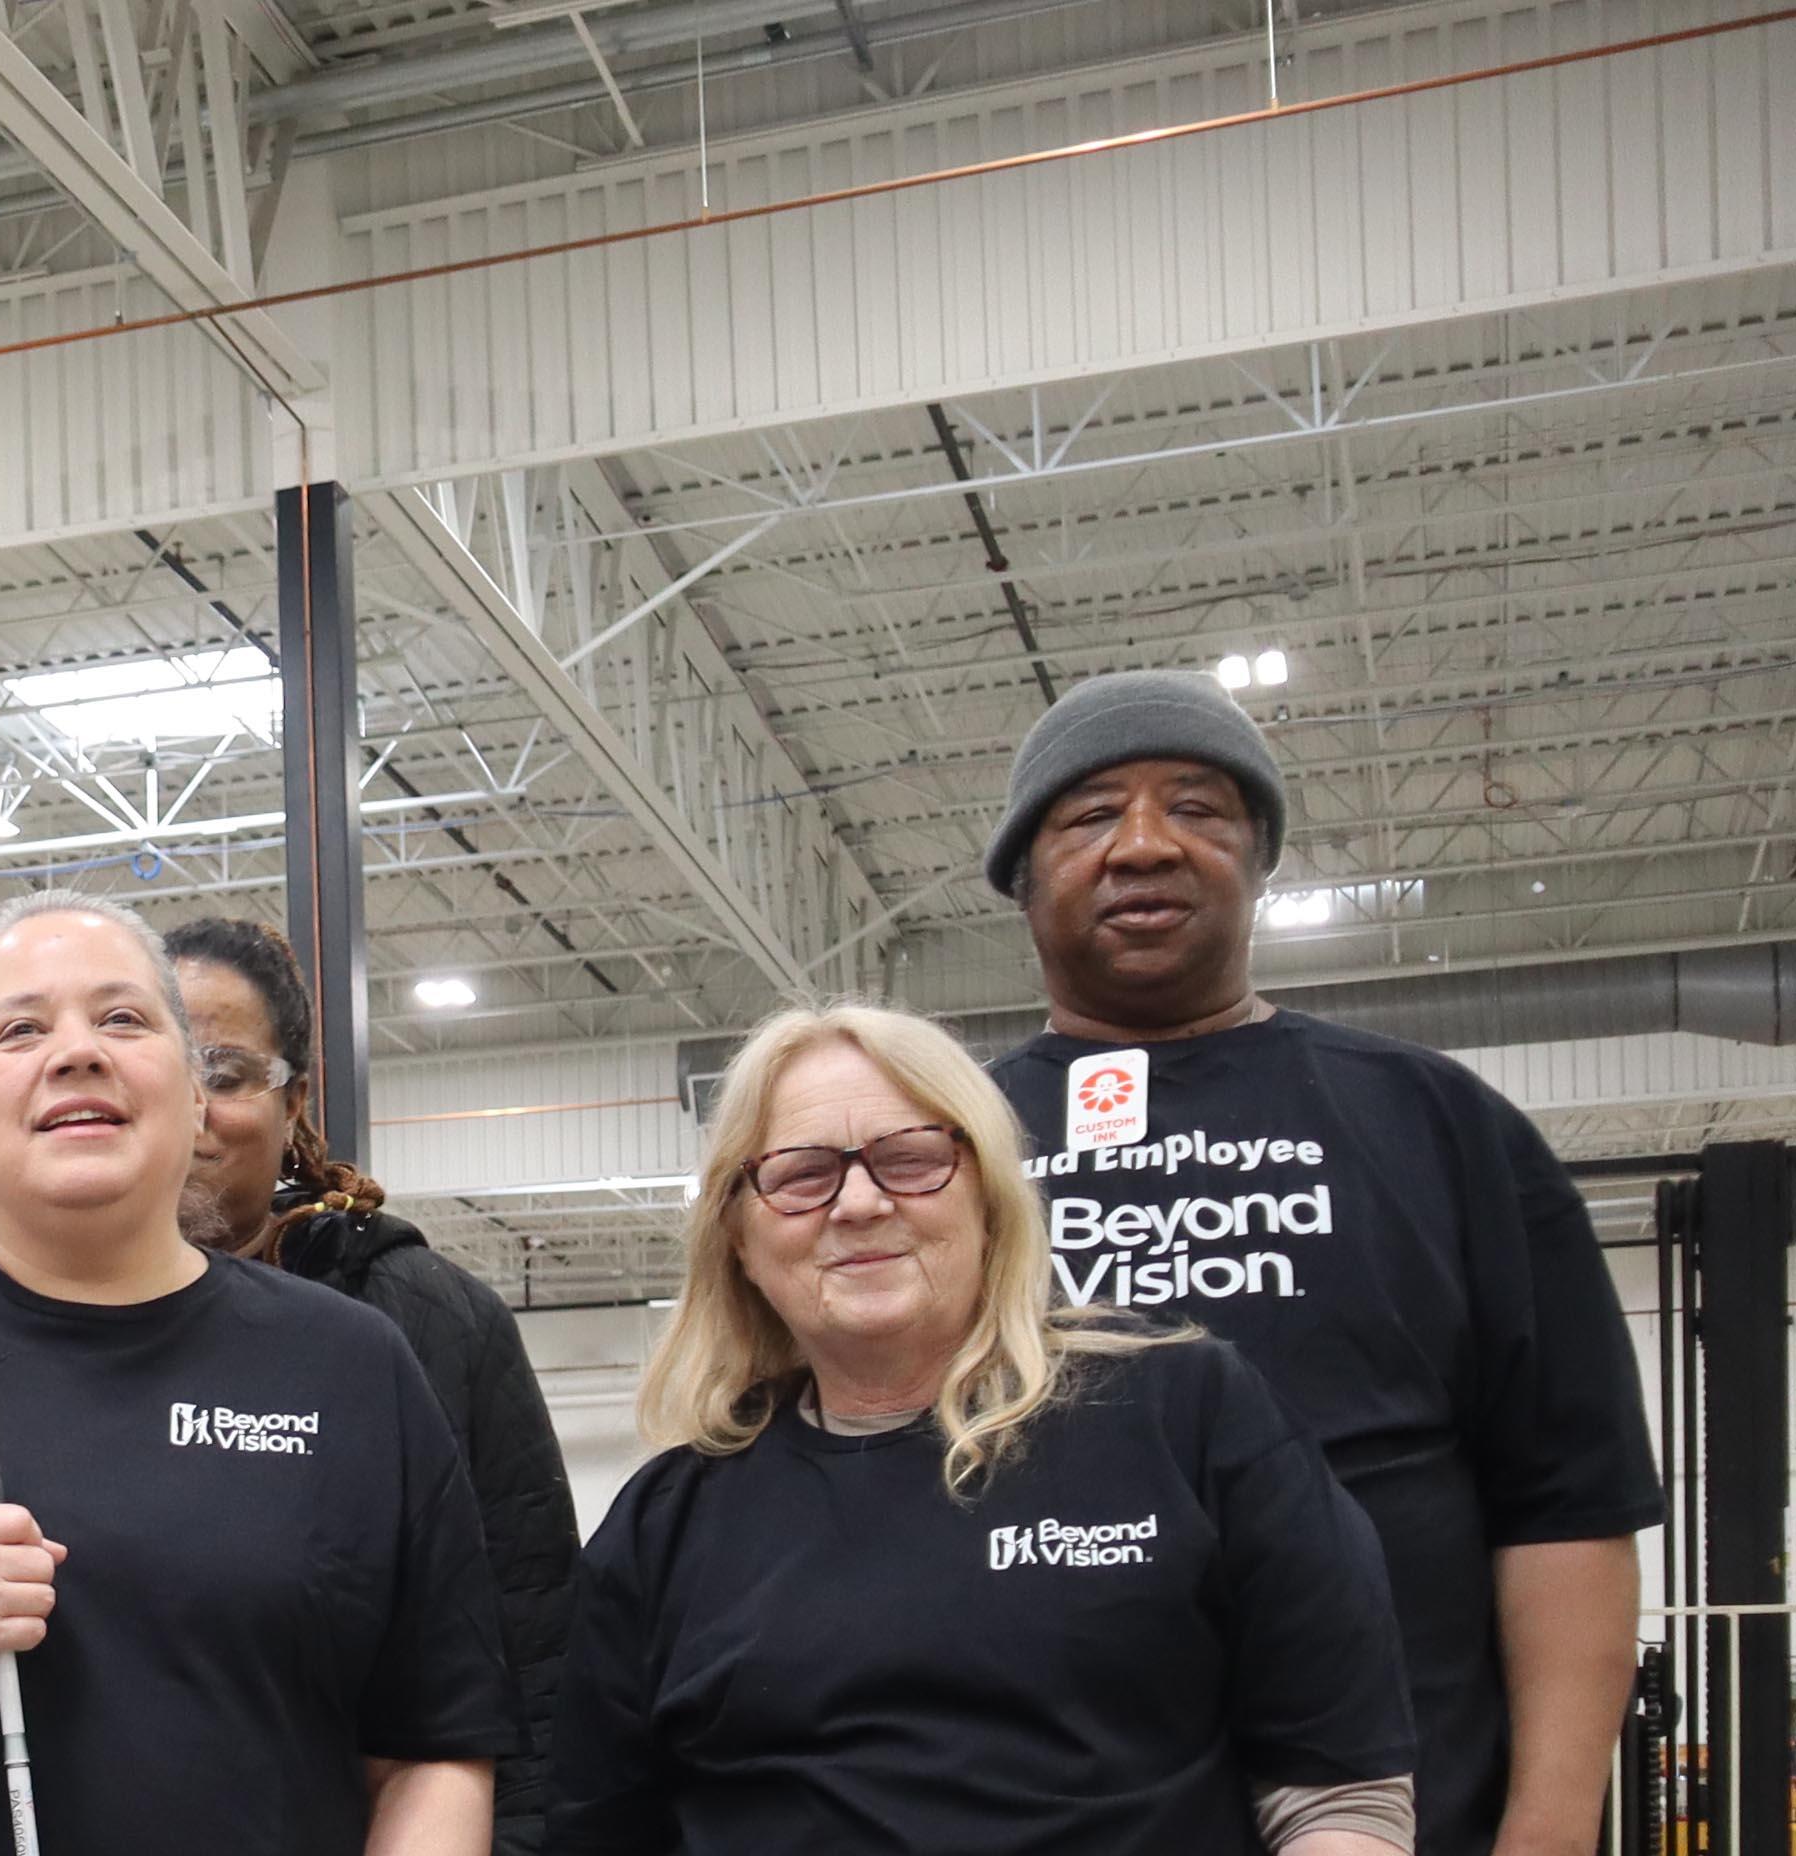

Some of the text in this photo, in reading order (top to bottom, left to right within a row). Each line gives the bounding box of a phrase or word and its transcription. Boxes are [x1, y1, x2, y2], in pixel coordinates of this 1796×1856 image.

[1075, 1116, 1137, 1135] CUSTOM
[1093, 1130, 1118, 1144] INK
[1094, 1130, 1324, 1175] Employee
[1049, 1184, 1334, 1255] Beyond
[213, 1407, 319, 1435] Beyond
[1038, 1514, 1158, 1548] Beyond
